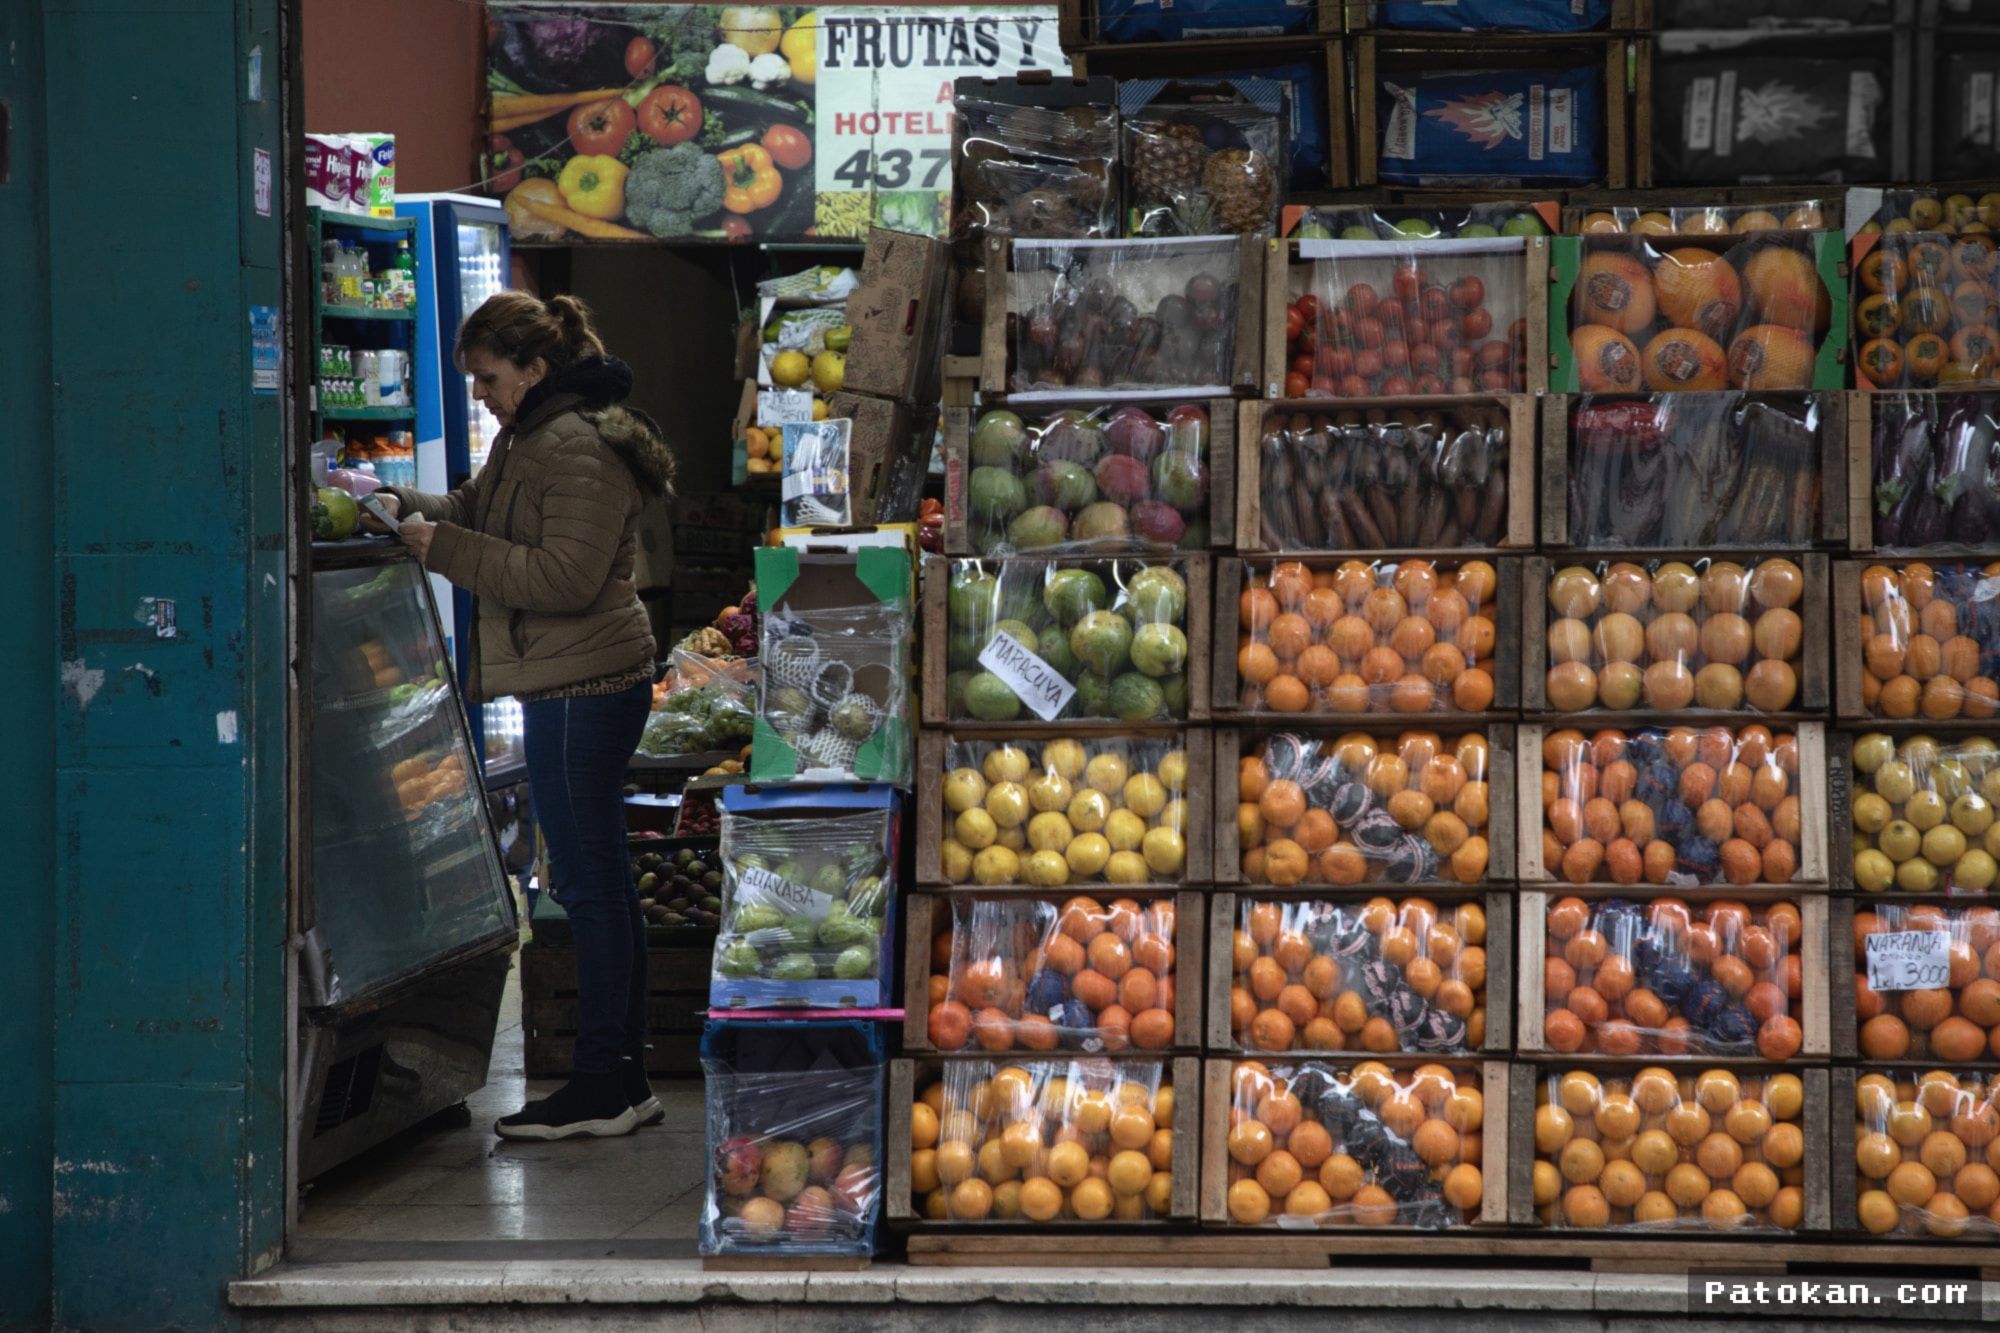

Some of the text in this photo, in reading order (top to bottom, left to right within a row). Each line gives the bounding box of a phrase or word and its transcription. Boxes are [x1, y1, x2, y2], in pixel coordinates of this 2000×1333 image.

[824, 16, 1042, 68] FRUTAS Y
[1866, 932, 1941, 955] NARANJA
[1903, 962, 1949, 987] 3000
